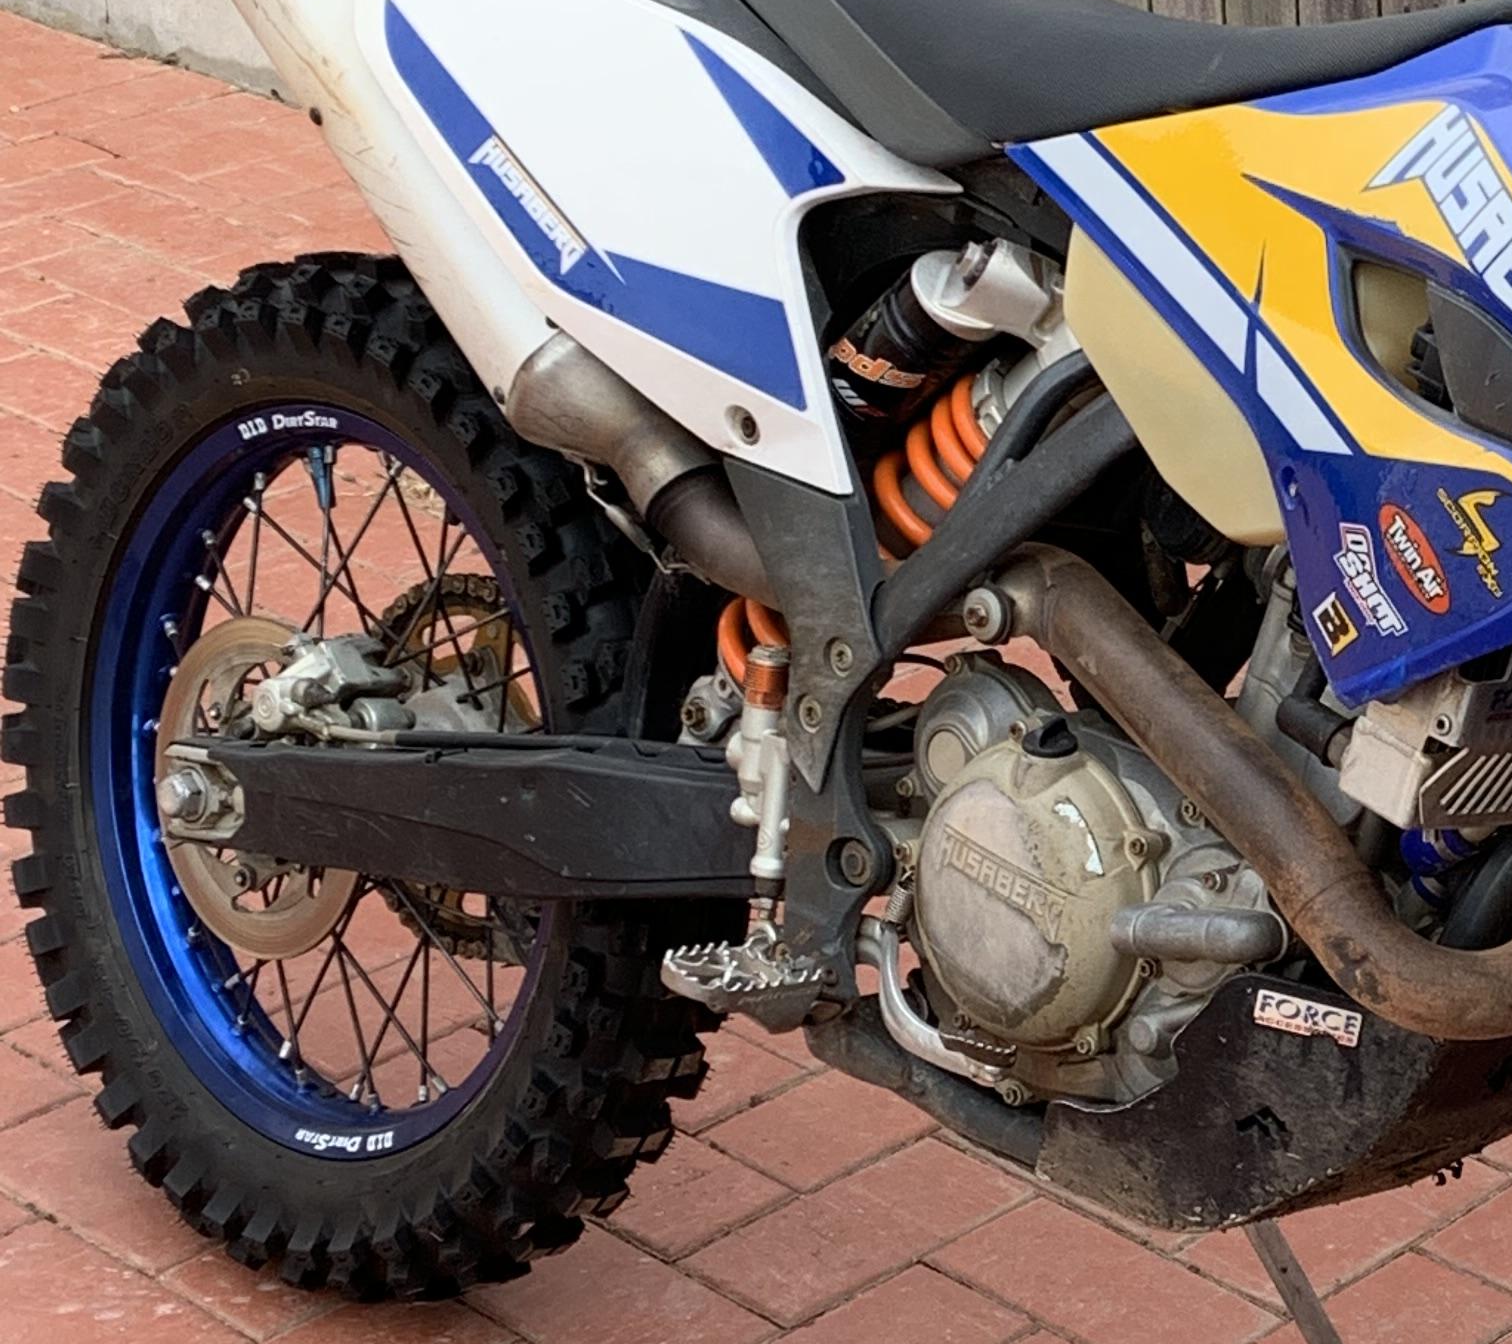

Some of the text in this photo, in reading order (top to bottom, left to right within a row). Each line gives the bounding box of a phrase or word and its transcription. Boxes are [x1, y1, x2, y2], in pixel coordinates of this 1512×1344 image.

[469, 136, 590, 275] HUSABERG
[1384, 514, 1445, 600] Twin Air
[935, 832, 1067, 943] HUSABERG
[1259, 994, 1359, 1036] FORCE
